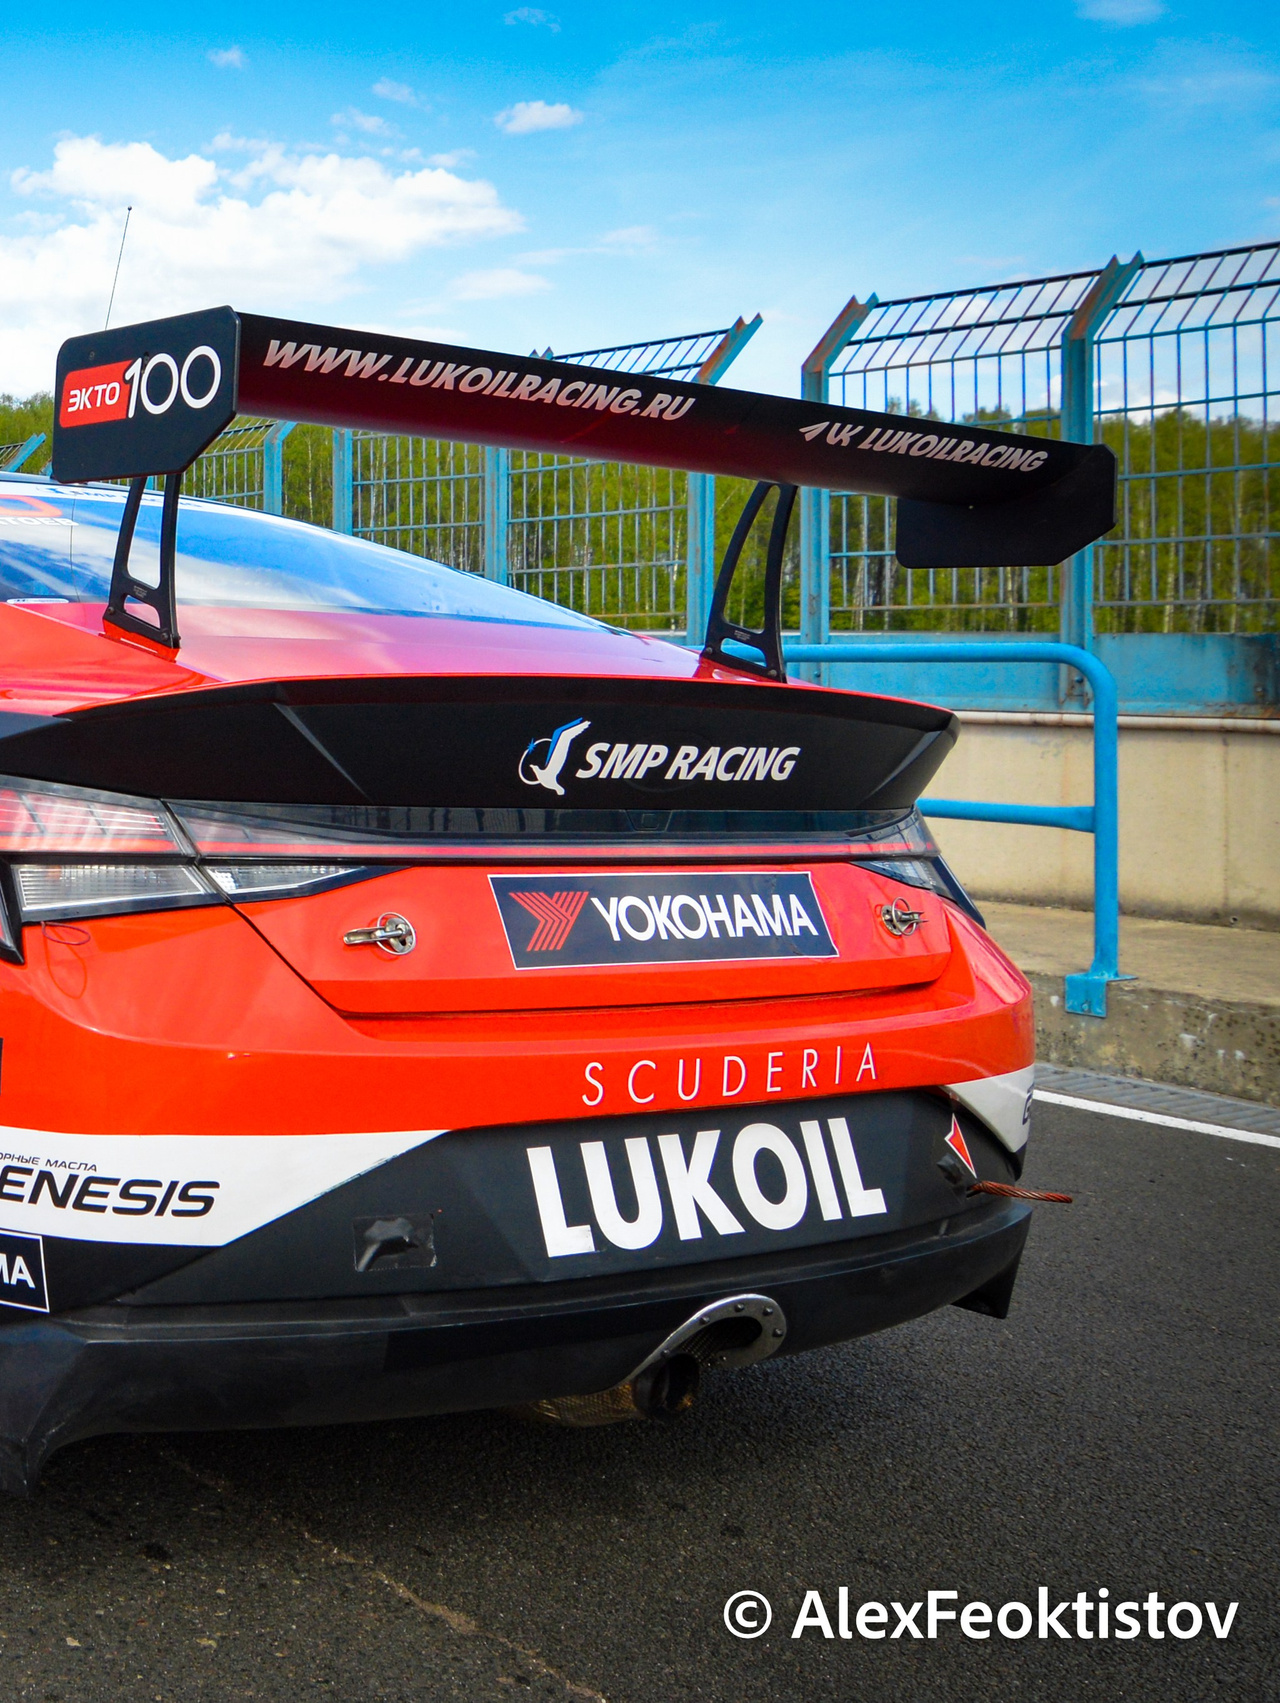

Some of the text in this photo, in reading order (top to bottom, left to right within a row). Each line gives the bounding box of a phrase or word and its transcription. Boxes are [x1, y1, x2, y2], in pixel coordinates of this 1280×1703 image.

[67, 344, 222, 419] ЭКТО 100
[262, 338, 696, 422] WWW.LUKOILRACING.RU
[857, 427, 1049, 473] LUKOILRACING
[575, 742, 801, 782] SMP RACING
[590, 892, 819, 942] YOKOHAMA
[581, 1042, 878, 1107] SCUDERIA
[45, 1157, 99, 1173] МАСЛА
[526, 1117, 888, 1258] LUKOIL
